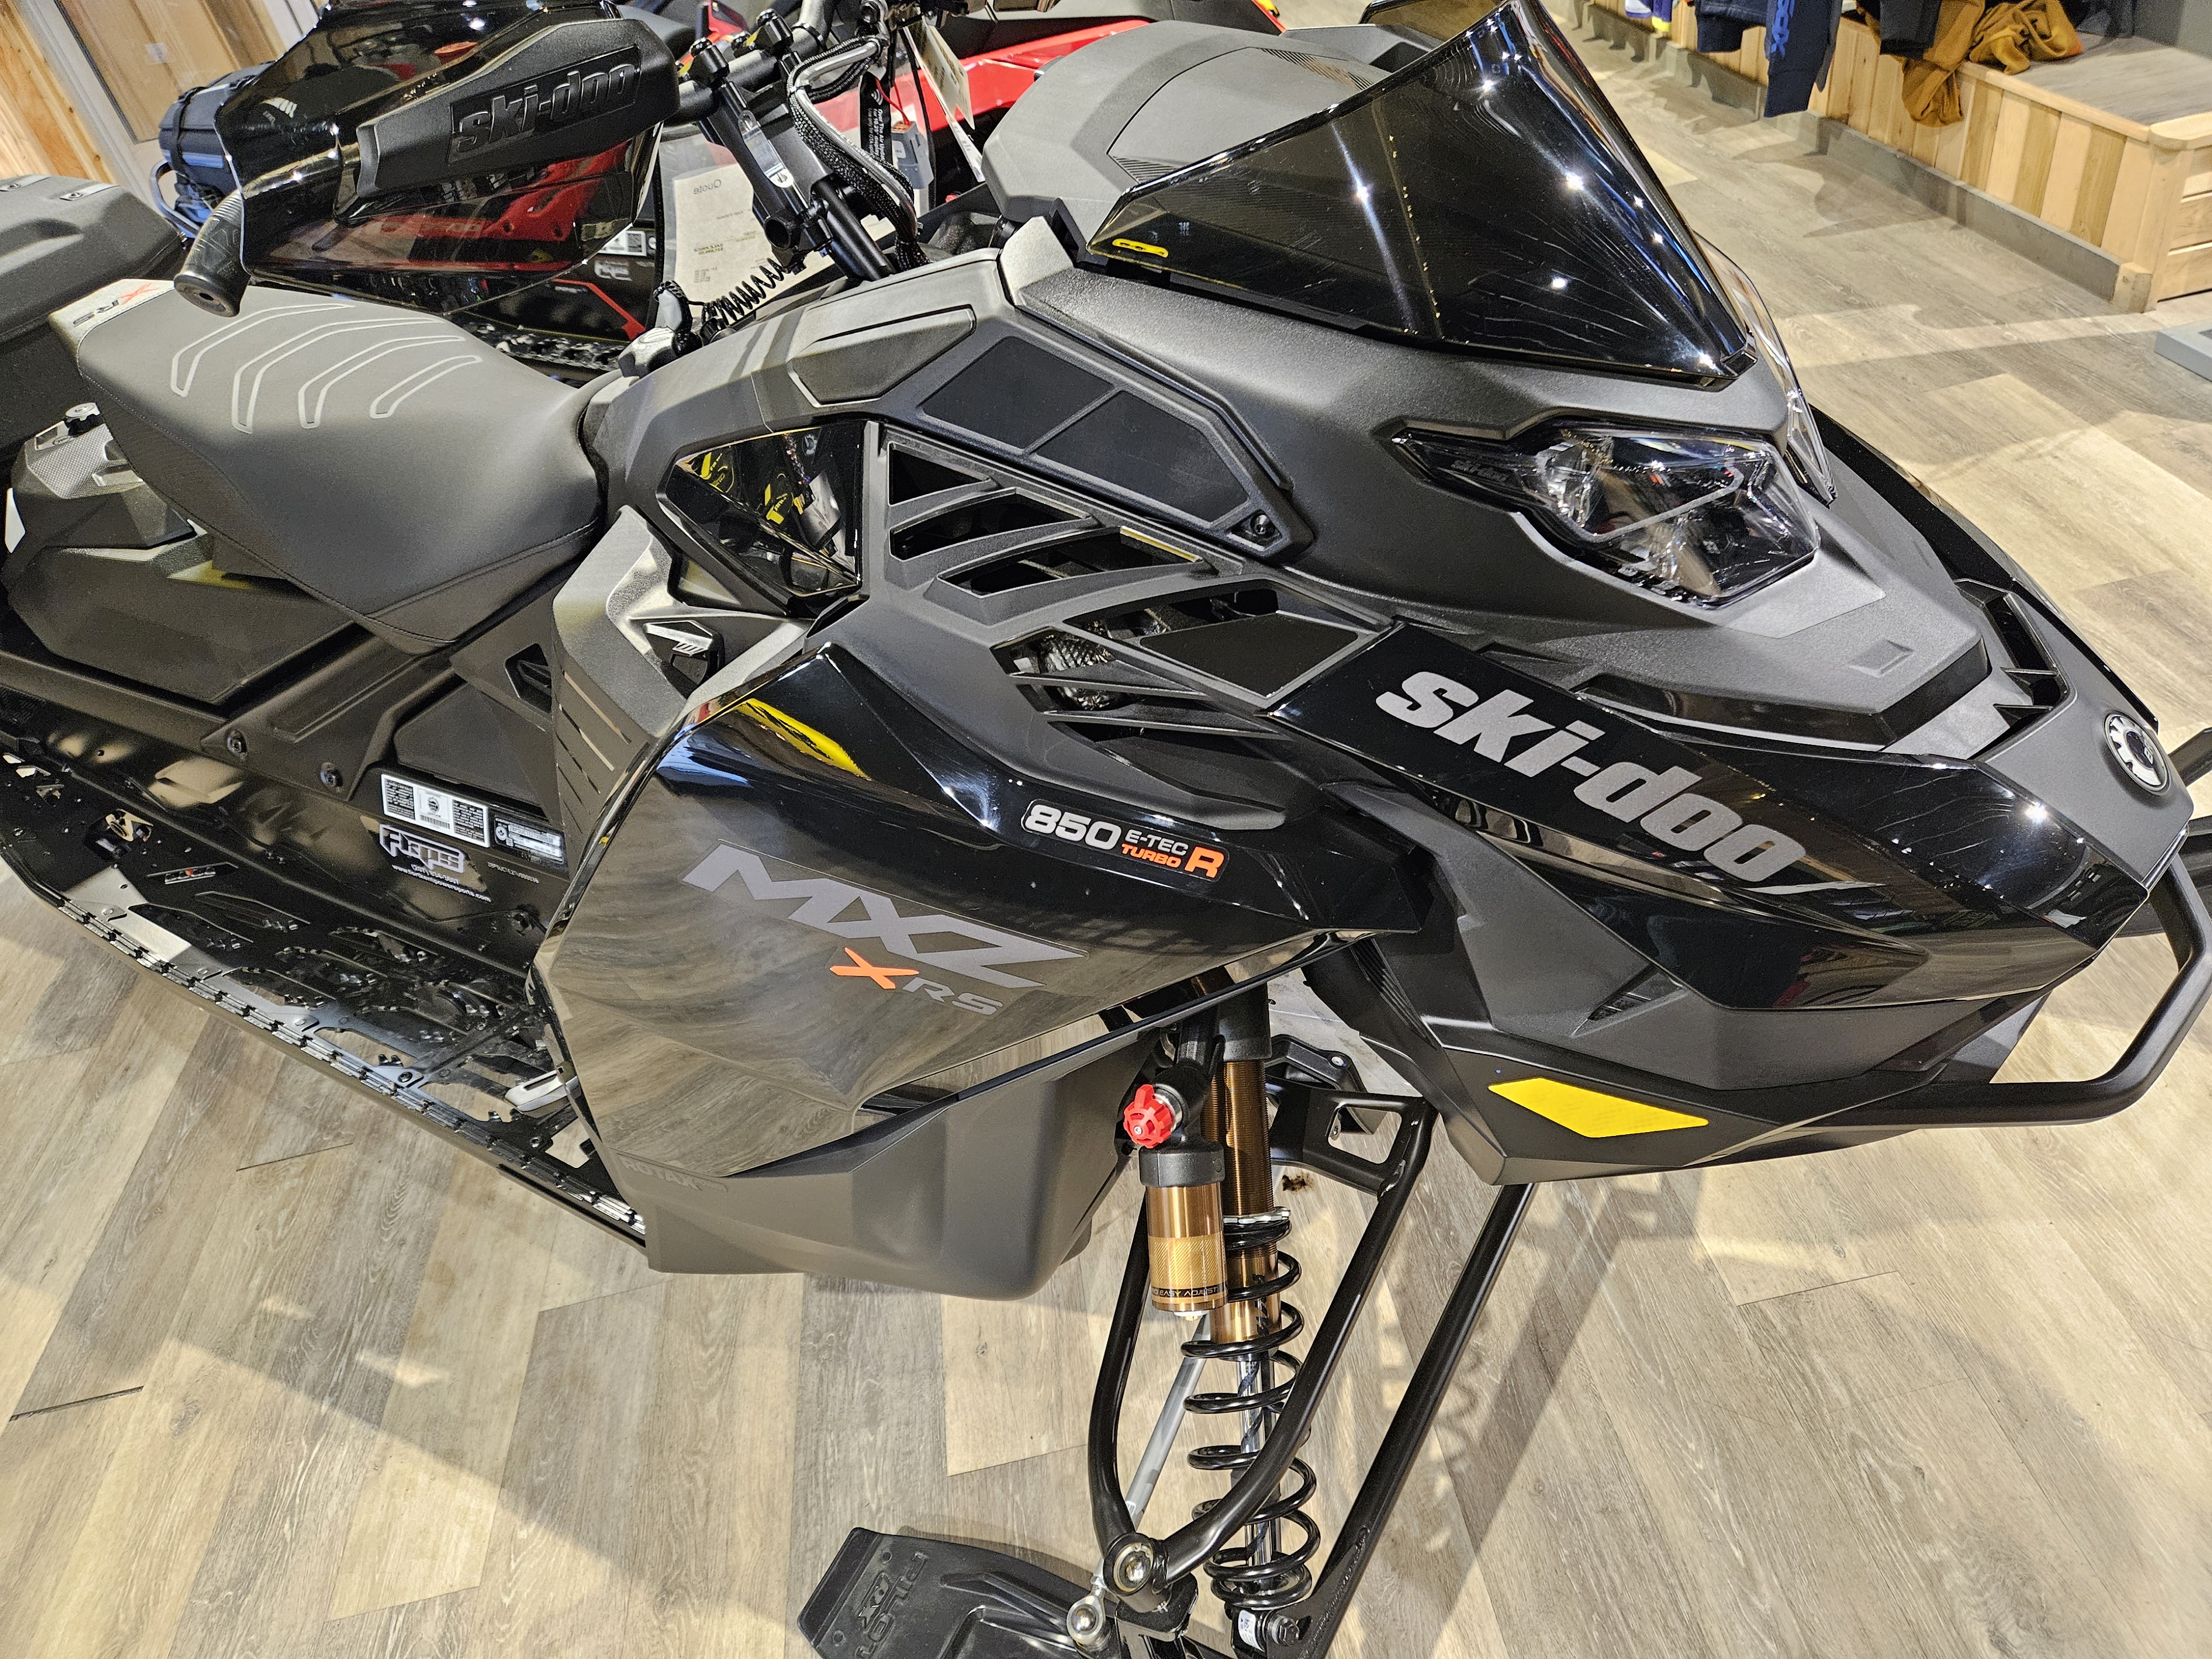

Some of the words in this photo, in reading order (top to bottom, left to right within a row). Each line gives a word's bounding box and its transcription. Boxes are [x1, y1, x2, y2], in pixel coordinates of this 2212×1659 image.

[458, 64, 635, 153] ski-doo
[1376, 671, 1807, 882] ski-doo
[1025, 805, 1121, 850] 850
[1125, 830, 1188, 856] E-TEC
[1121, 843, 1181, 868] TURBO
[1184, 846, 1224, 878] R
[682, 844, 1086, 989] MXZ
[1160, 1289, 1181, 1297] EASY
[1183, 1287, 1217, 1297] ADJUST
